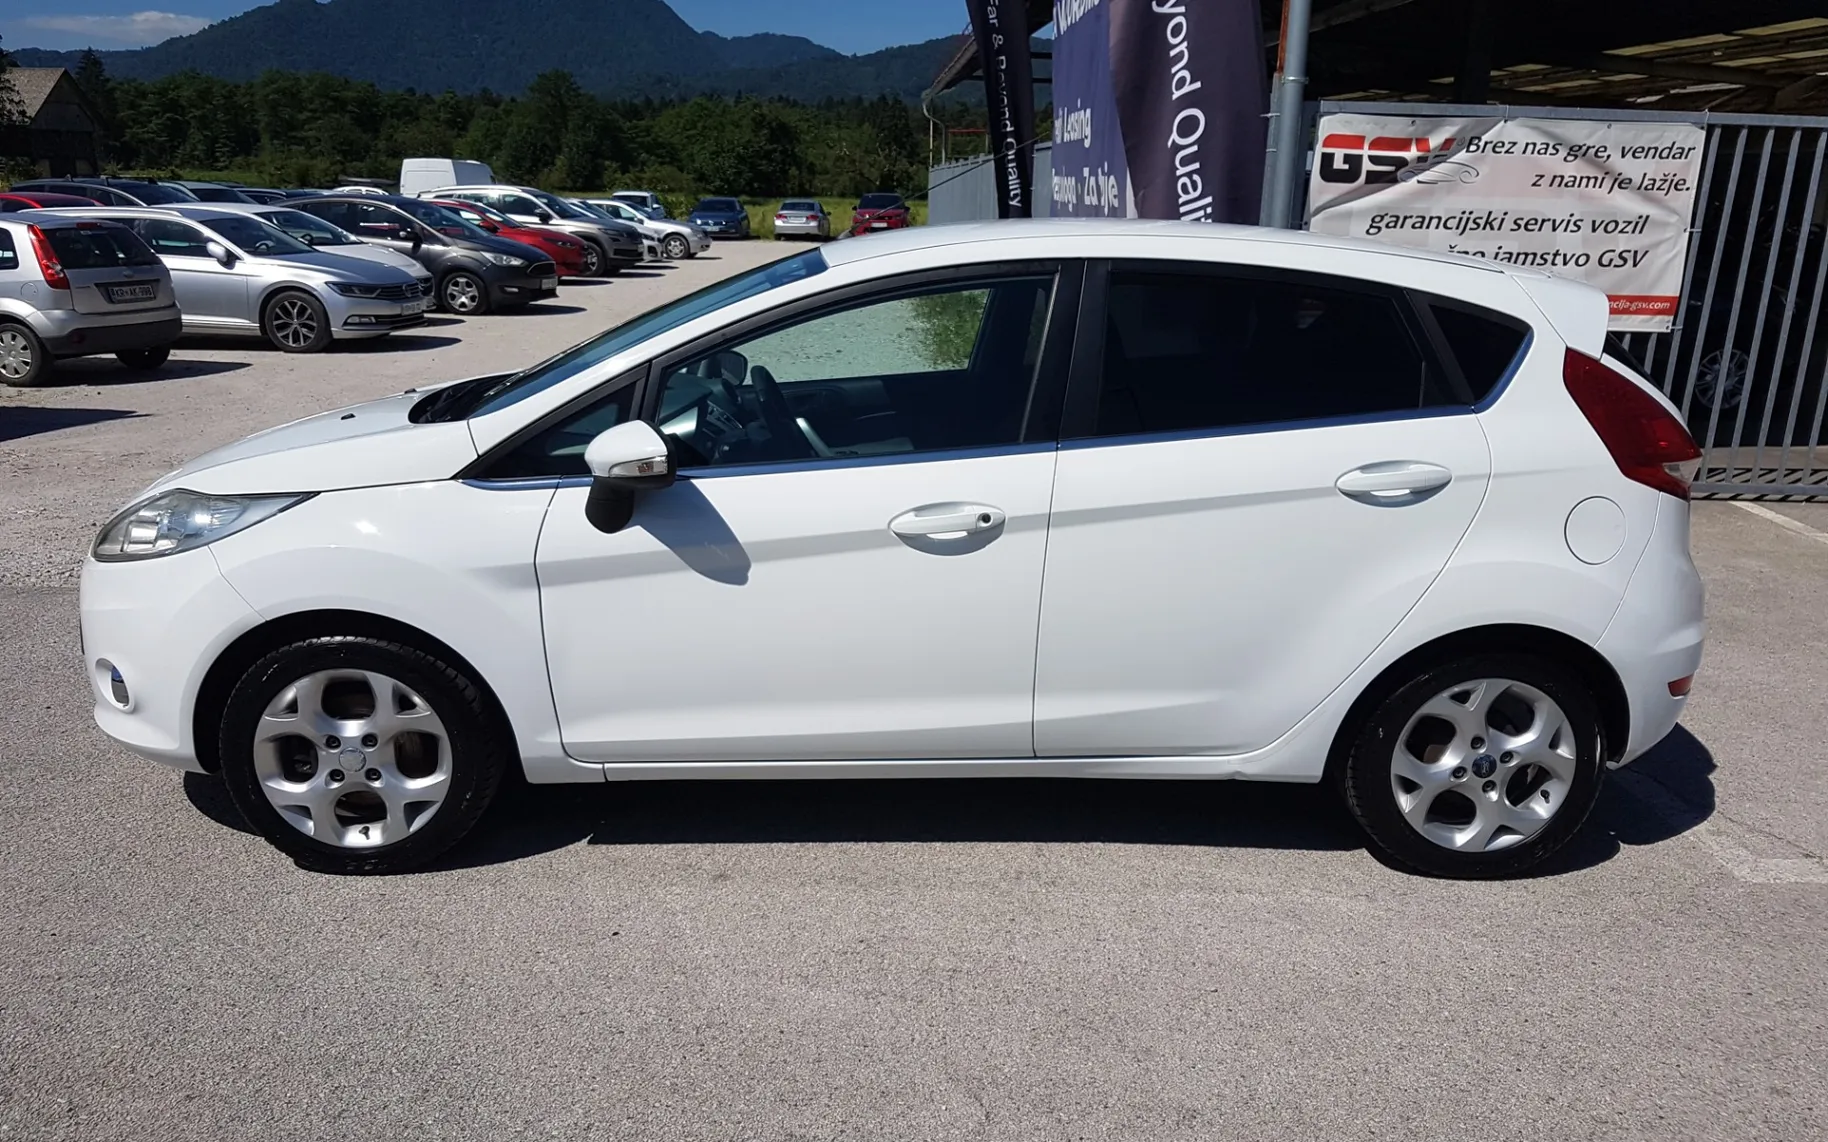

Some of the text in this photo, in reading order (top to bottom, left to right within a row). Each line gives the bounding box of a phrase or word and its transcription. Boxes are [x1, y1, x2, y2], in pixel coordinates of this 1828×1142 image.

[992, 33, 1004, 50] &
[1465, 135, 1697, 163] Brez nas gre, vendar
[1167, 107, 1213, 222] Quali
[1530, 171, 1692, 197] z nami je lažje.
[1365, 210, 1651, 236] garancijski servis vozil
[1597, 249, 1651, 268] GSV
